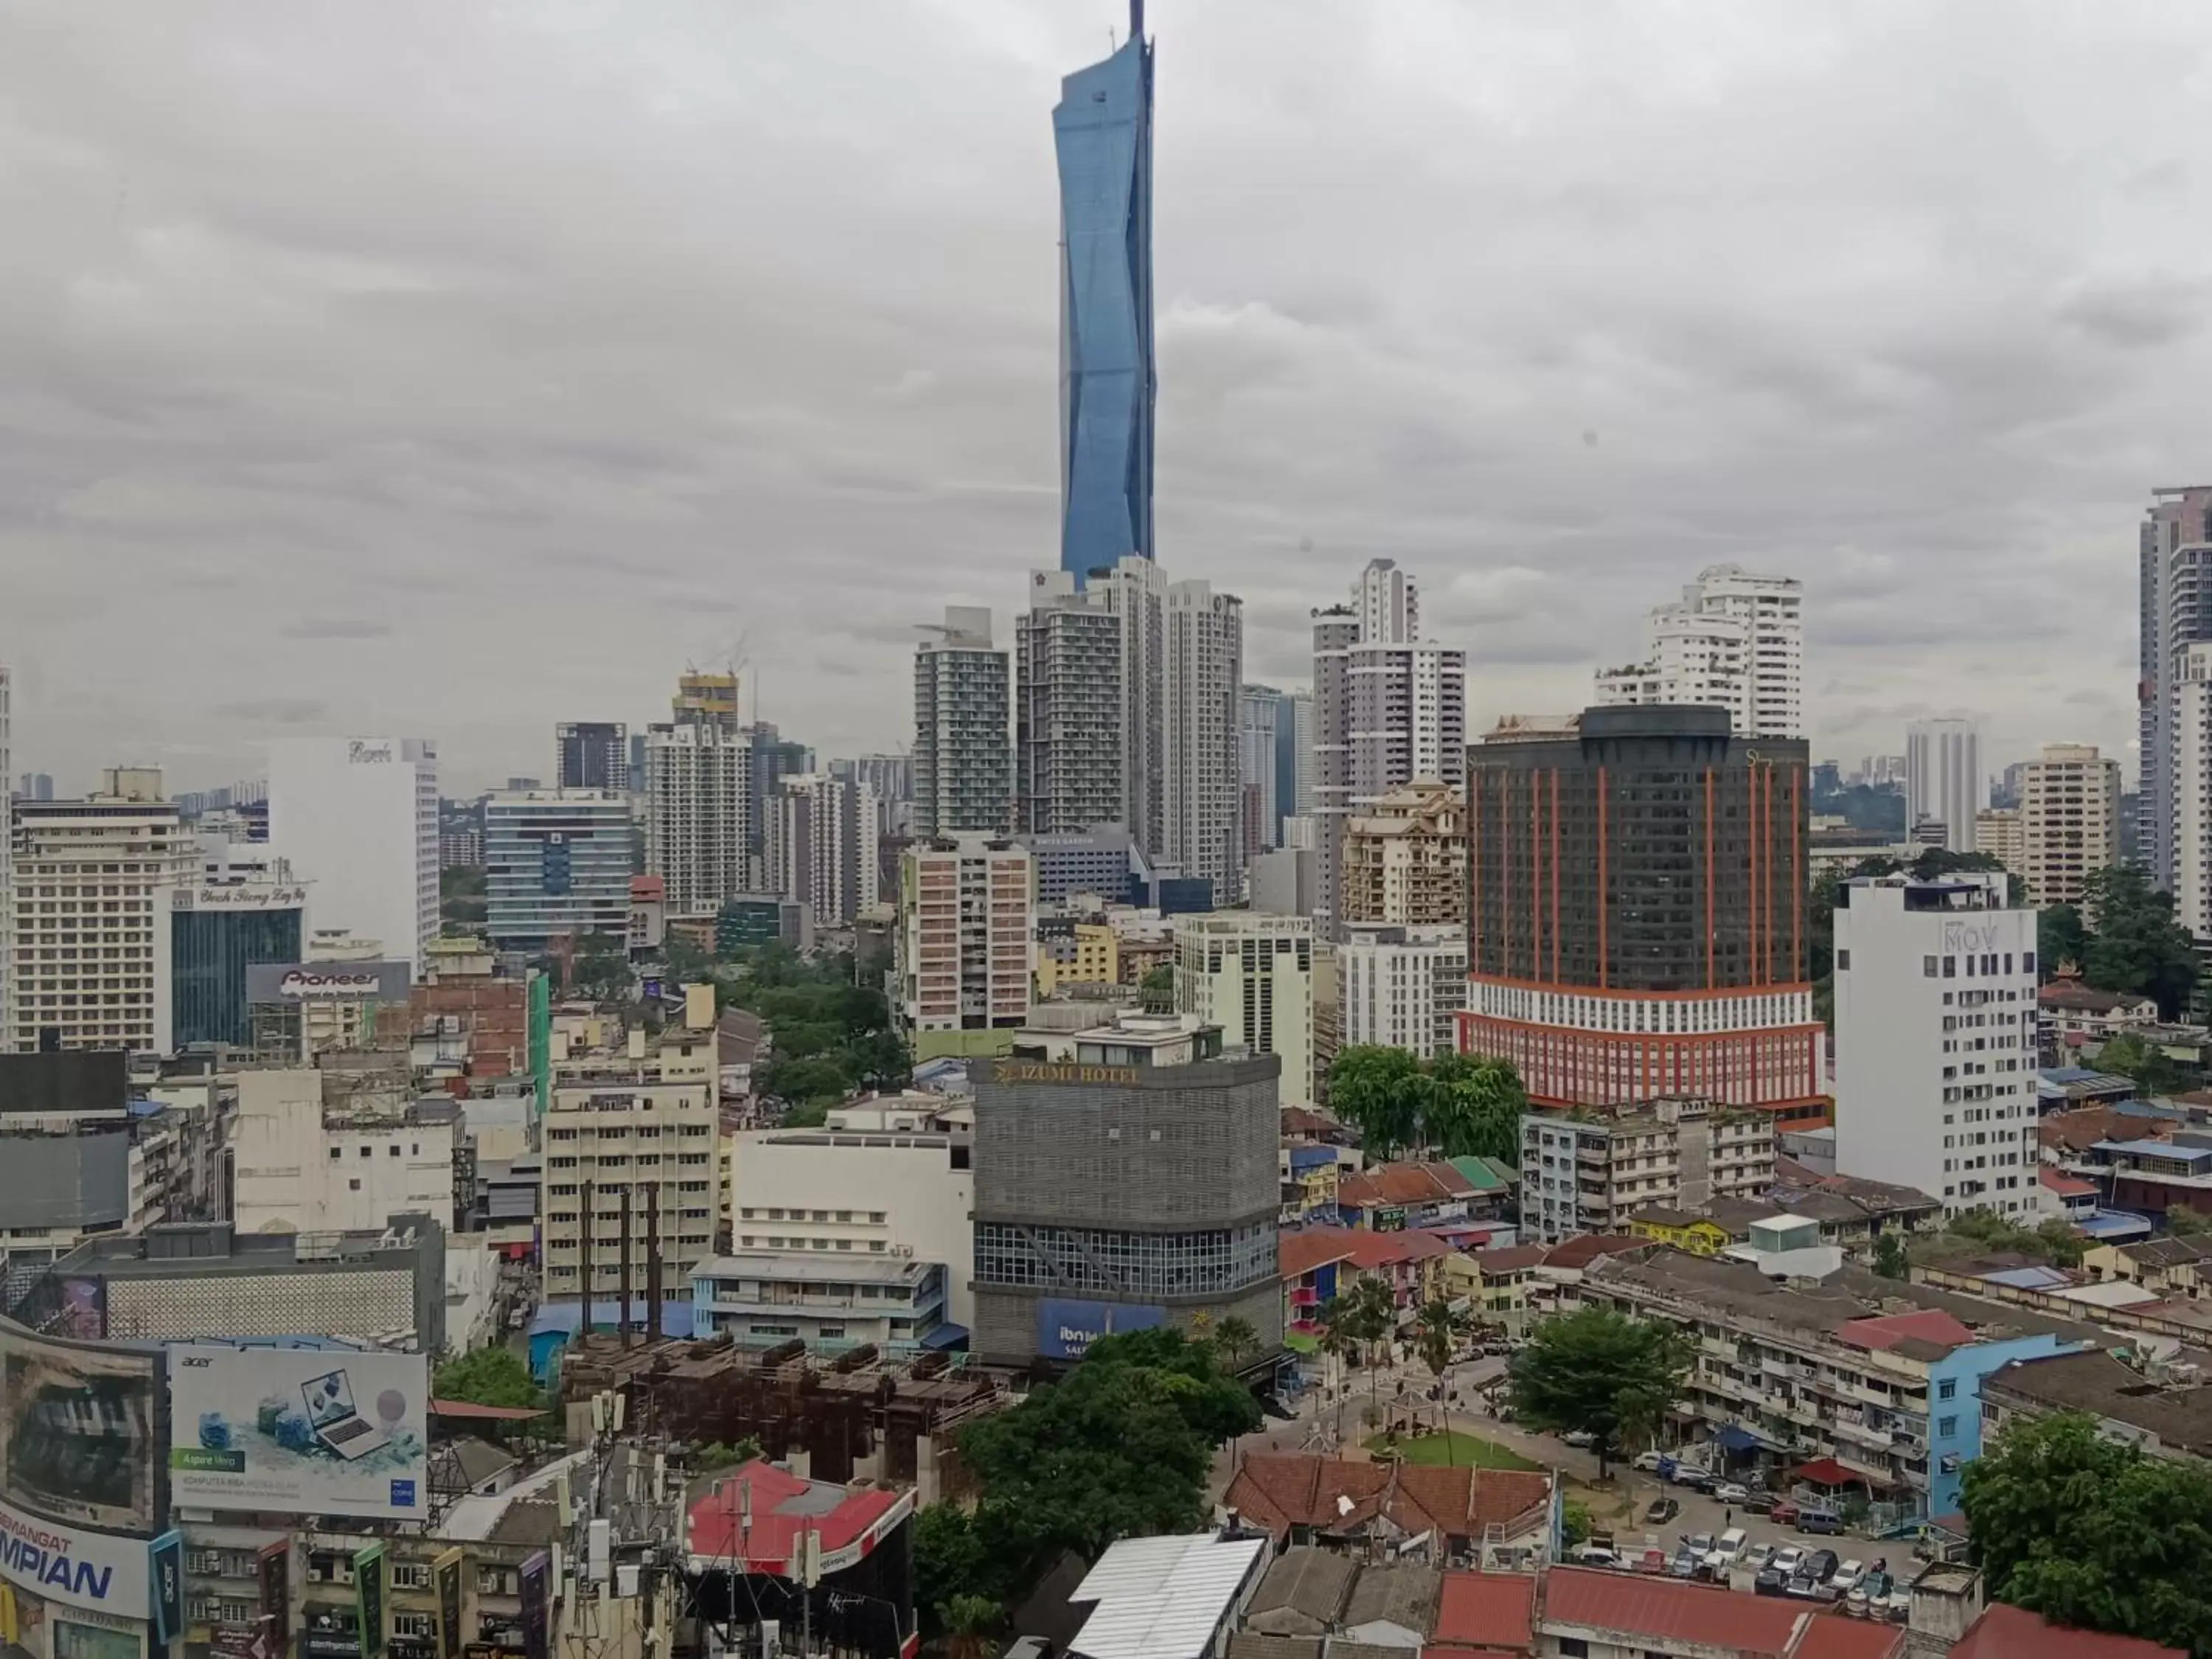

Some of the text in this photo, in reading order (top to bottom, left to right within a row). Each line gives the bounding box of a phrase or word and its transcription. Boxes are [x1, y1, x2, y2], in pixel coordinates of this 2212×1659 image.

[281, 970, 380, 986] Pioneer
[1020, 1065, 1139, 1083] IZUMI HOTEL
[1060, 1326, 1084, 1342] ibn
[181, 1356, 214, 1368] acer
[164, 1562, 175, 1604] acer
